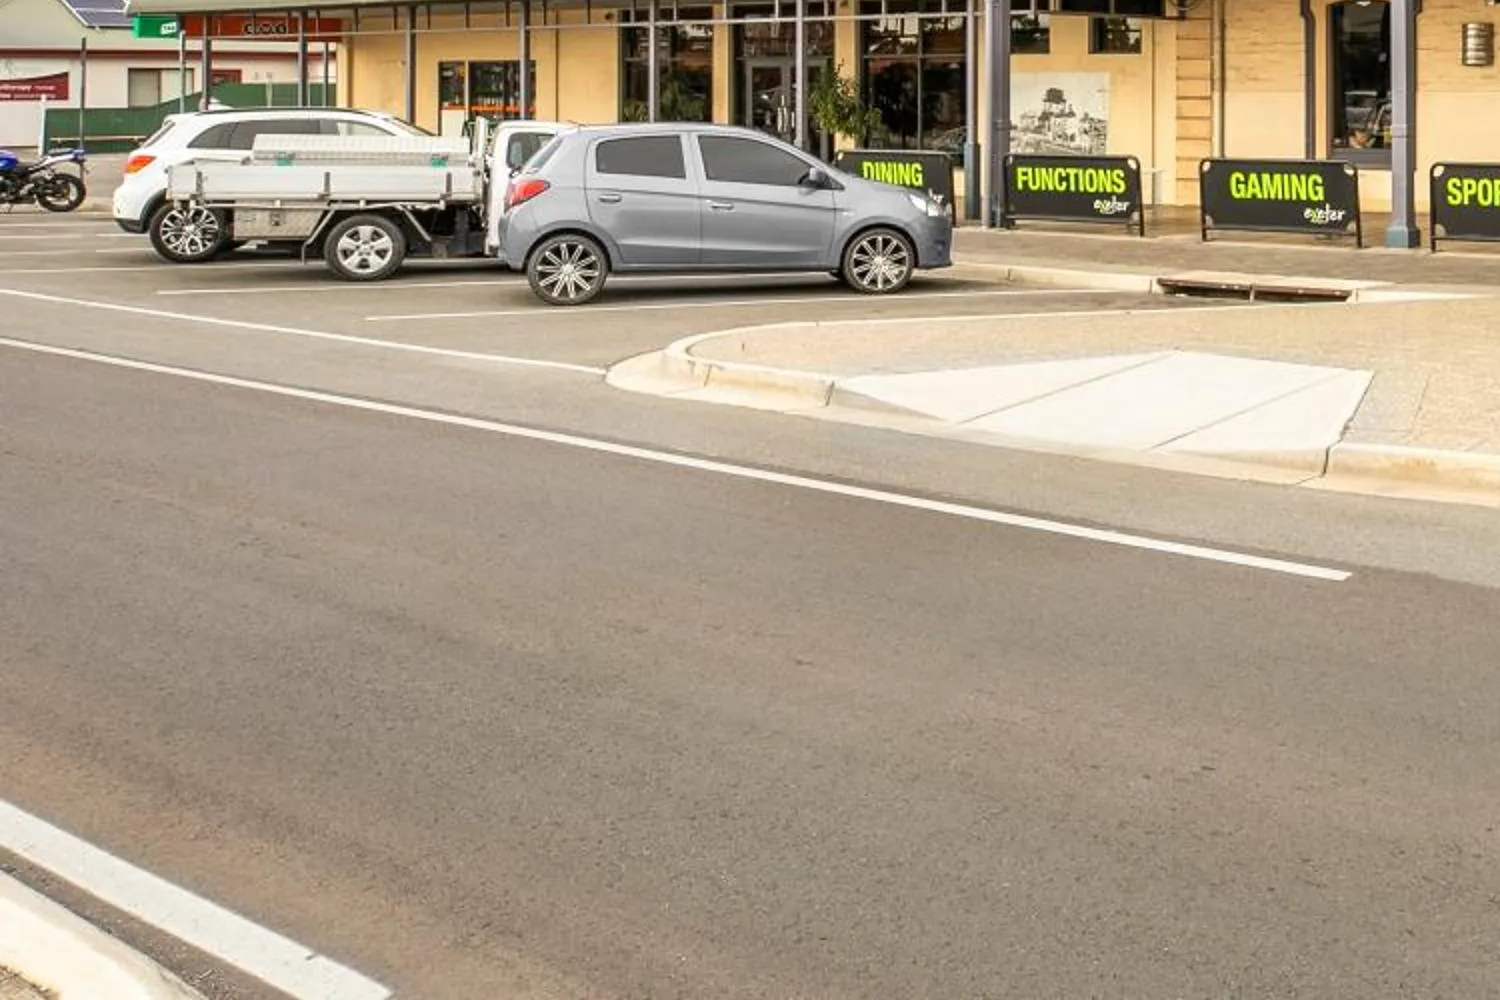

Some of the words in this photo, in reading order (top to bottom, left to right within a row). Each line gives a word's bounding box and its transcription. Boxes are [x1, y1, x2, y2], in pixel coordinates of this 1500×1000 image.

[862, 161, 924, 186] DINING
[1015, 167, 1126, 193] FUNCTIONS
[1229, 171, 1325, 201] GAMING
[1093, 195, 1130, 215] exeter
[1303, 203, 1346, 224] exeter
